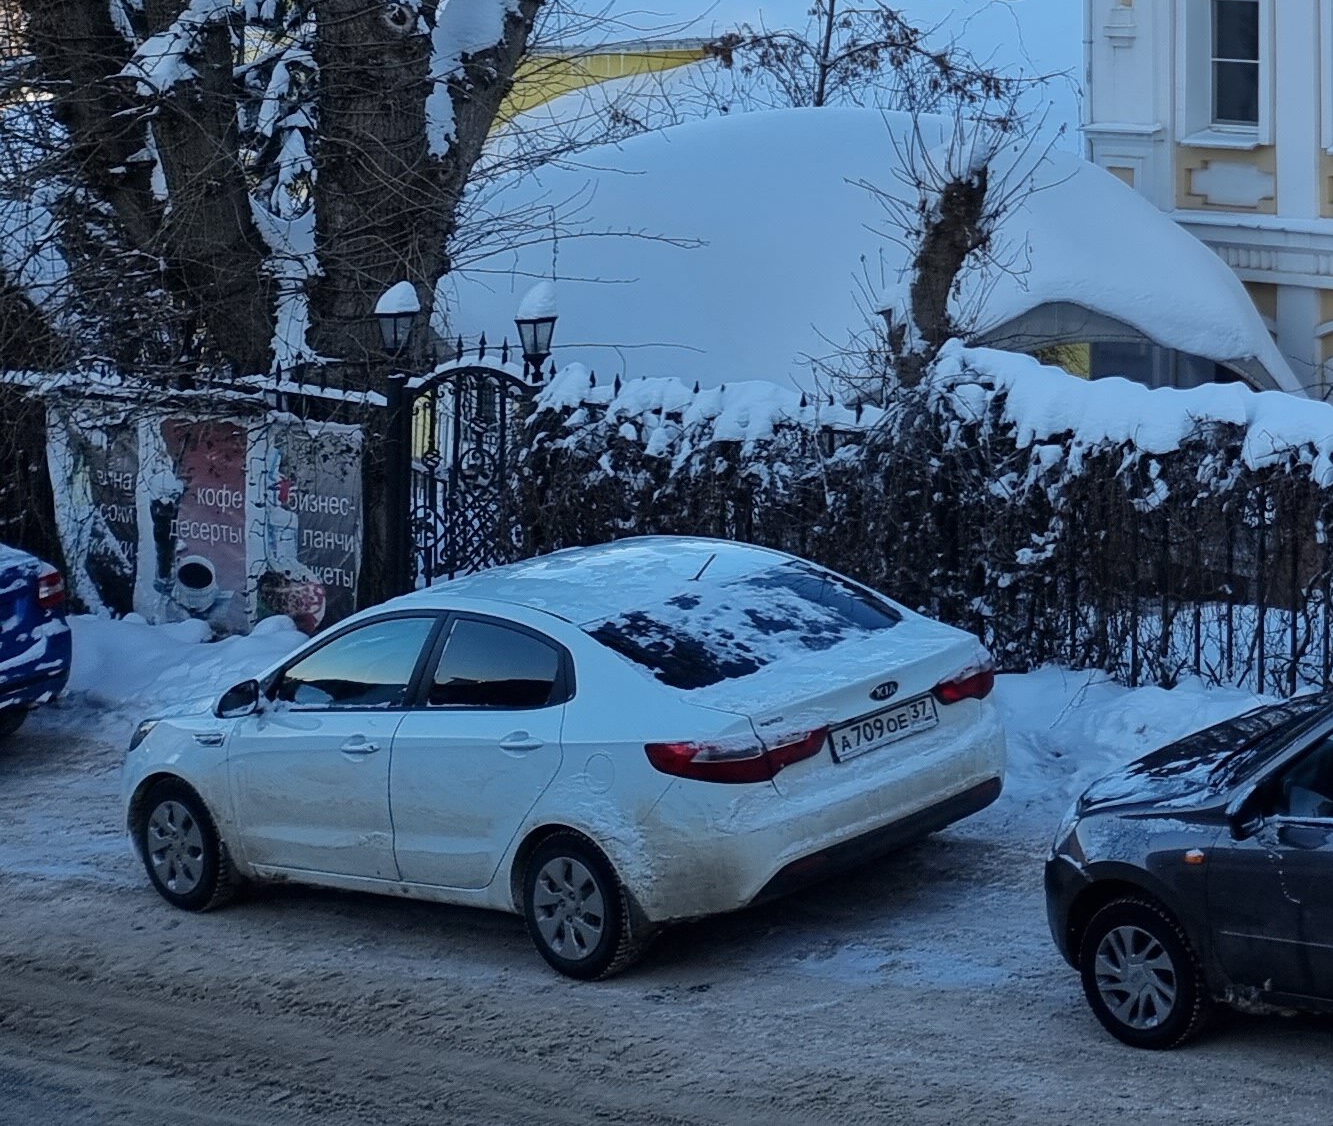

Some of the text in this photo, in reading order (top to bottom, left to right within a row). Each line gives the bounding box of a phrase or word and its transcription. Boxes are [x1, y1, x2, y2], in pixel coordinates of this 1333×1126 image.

[197, 484, 243, 512] кофе
[287, 485, 355, 516] бизнес-
[100, 503, 135, 524] соки
[169, 519, 244, 545] десерты
[302, 529, 355, 553] ланчи
[876, 683, 896, 699] KIA
